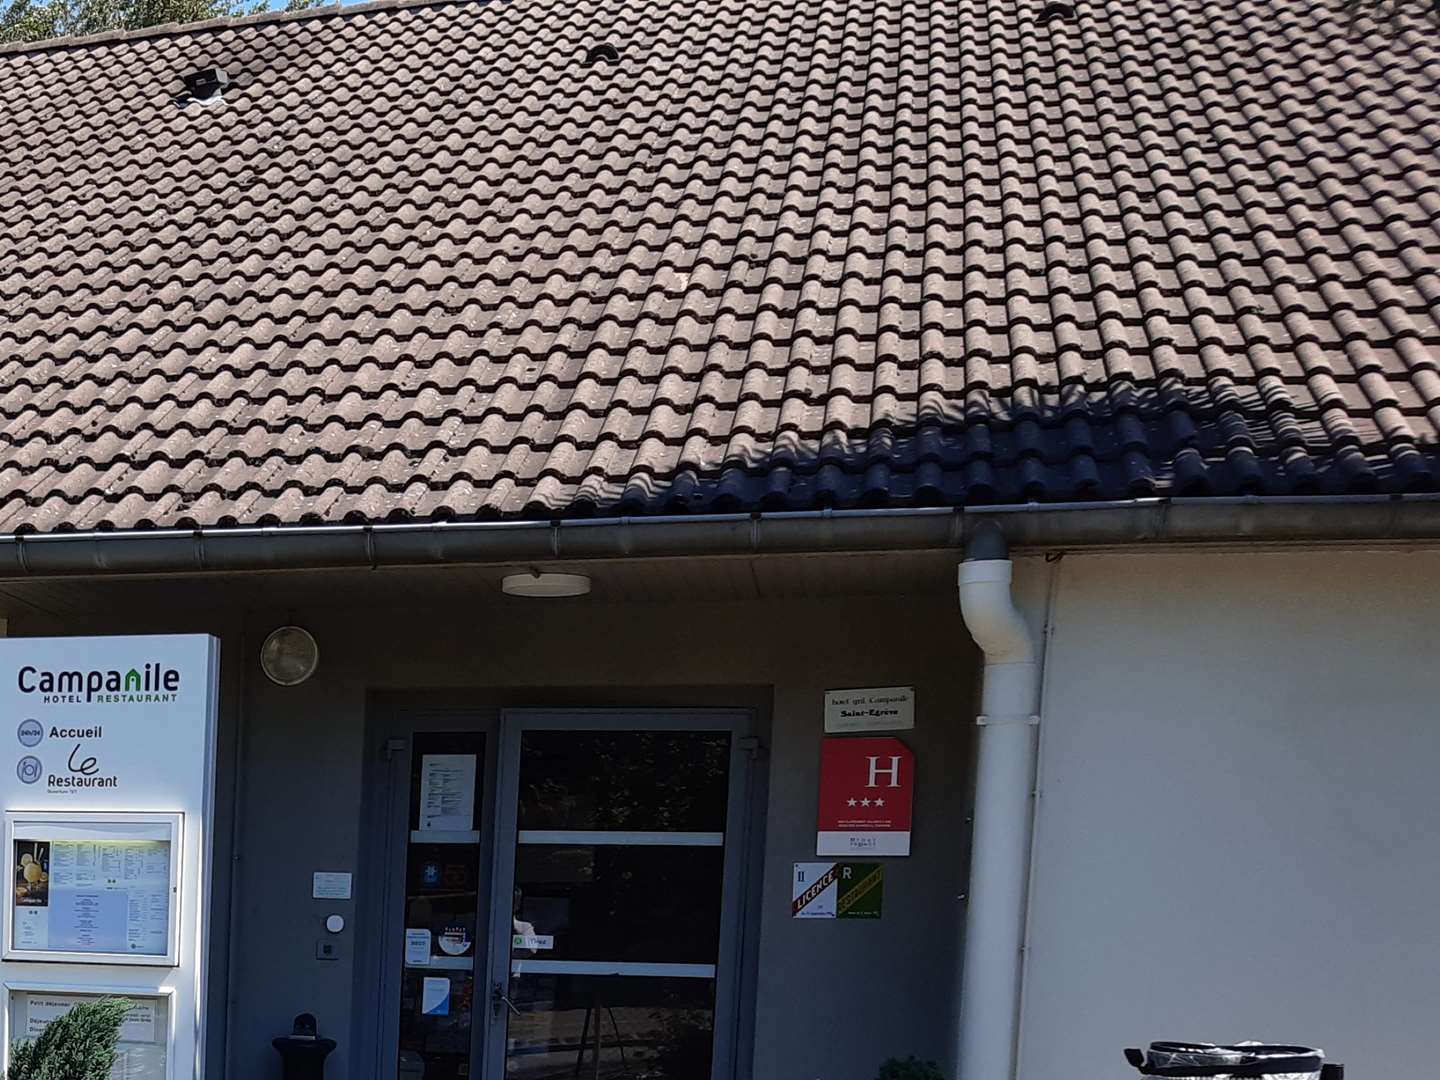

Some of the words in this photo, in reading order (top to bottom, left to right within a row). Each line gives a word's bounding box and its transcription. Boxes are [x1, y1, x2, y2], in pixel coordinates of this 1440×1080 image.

[18, 662, 180, 702] Campanile
[44, 695, 82, 703] HOTEL
[97, 694, 177, 703] RESTAURANT
[49, 726, 103, 738] Accueil
[68, 743, 100, 775] Le
[48, 774, 118, 787] Restaurant
[865, 756, 902, 787] H
[843, 867, 852, 879] R
[796, 869, 834, 909] LICENCE
